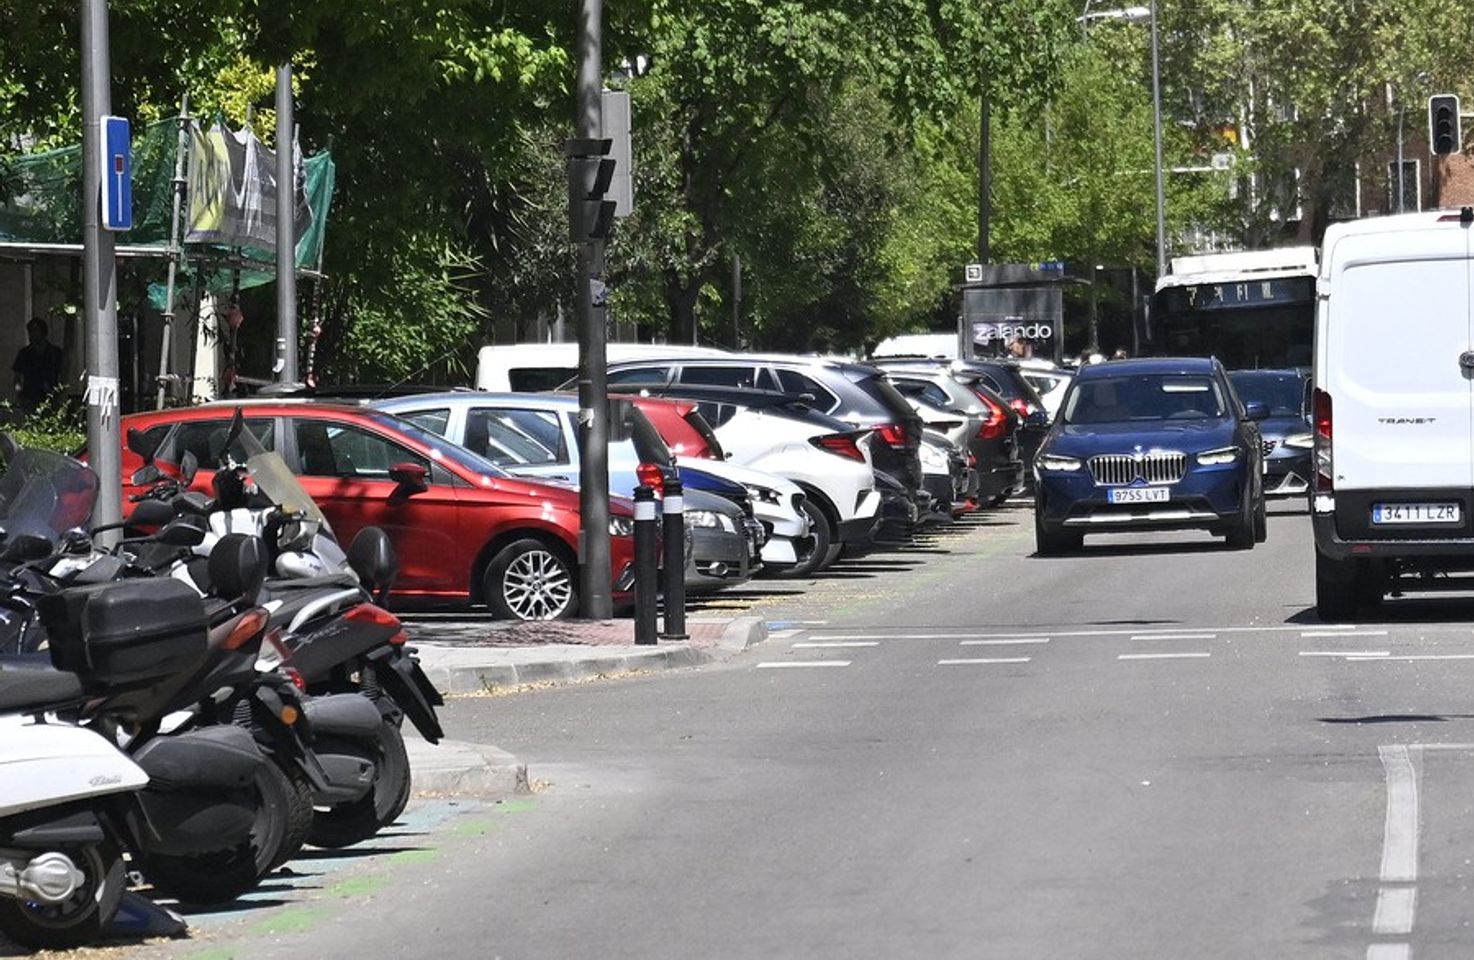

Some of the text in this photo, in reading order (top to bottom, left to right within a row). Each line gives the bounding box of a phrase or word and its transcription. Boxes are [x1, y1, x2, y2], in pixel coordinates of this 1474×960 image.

[975, 323, 1052, 340] zalando
[1115, 490, 1166, 501] 9755 LVT
[1384, 505, 1455, 519] 3411 LZR
